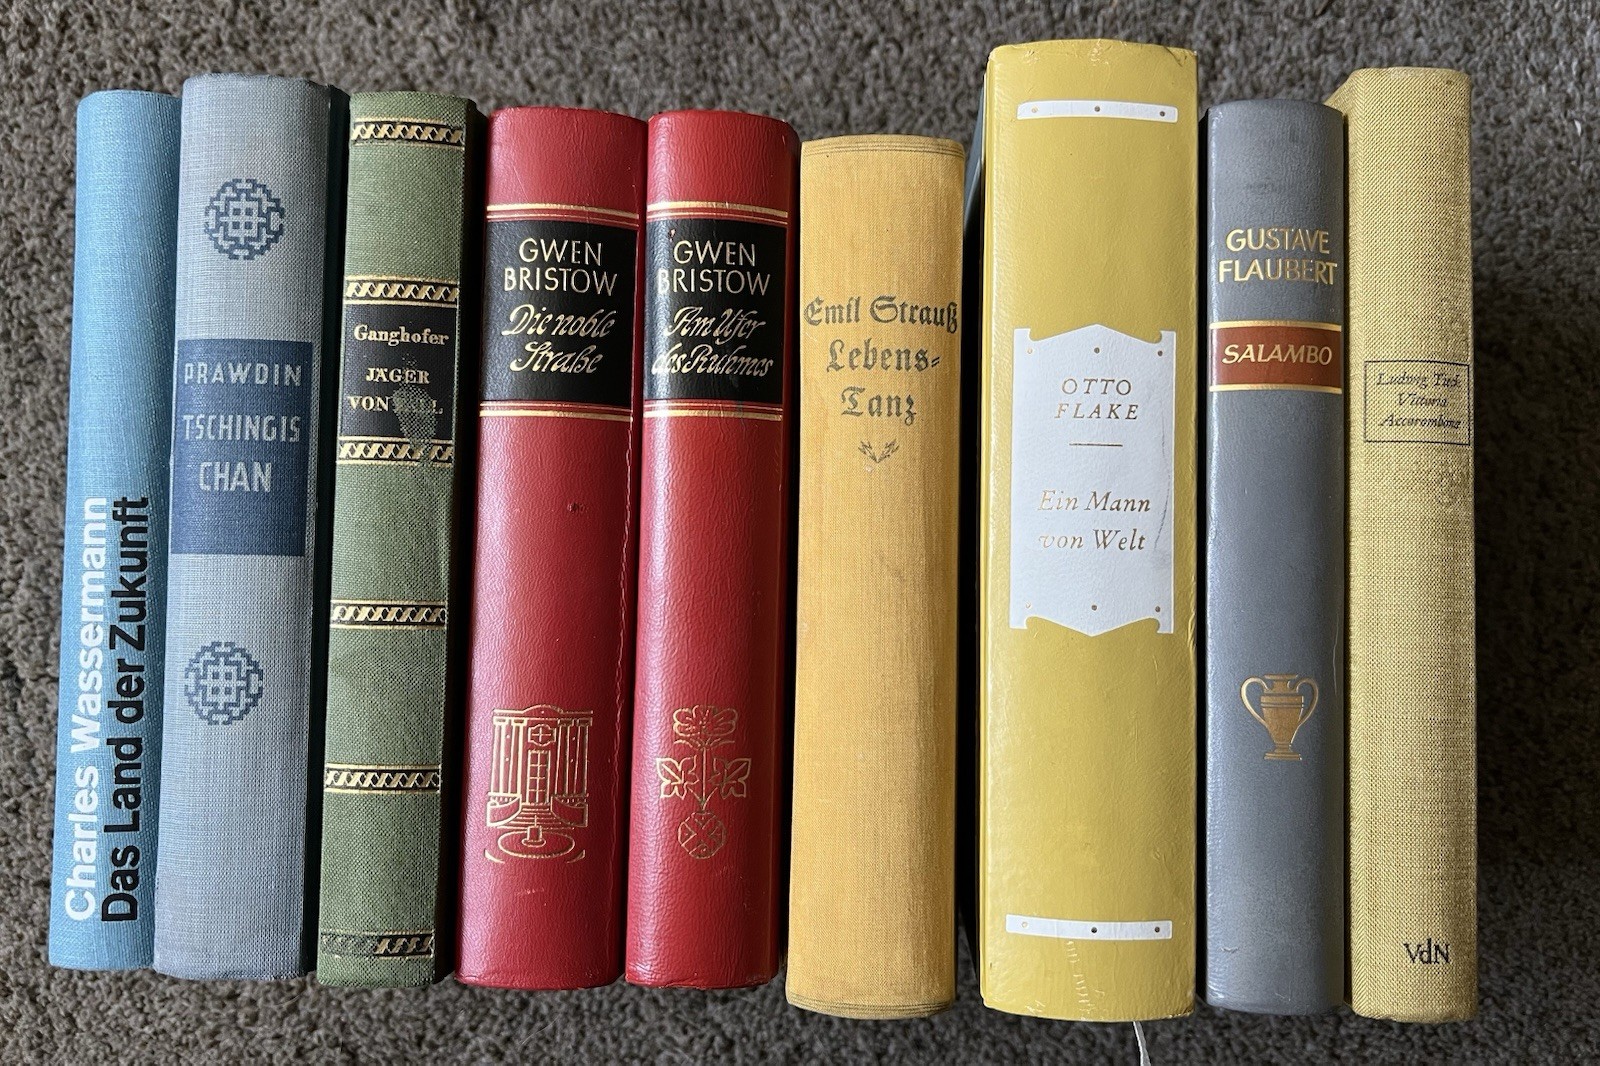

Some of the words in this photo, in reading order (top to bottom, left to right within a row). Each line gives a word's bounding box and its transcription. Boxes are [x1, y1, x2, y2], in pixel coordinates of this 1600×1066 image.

[518, 237, 602, 266] GWEN
[673, 240, 755, 267] GWEN
[1226, 227, 1330, 254] GUSTAVE
[503, 267, 618, 296] BRISTOW
[657, 268, 771, 296] BRISTOW
[1218, 259, 1338, 285] FLAUBERT
[501, 303, 550, 337] Die
[551, 308, 617, 338] noble
[663, 306, 716, 337] Am
[713, 308, 767, 345] Ufer
[803, 296, 861, 326] Emil
[869, 295, 958, 334] Strauß
[354, 324, 449, 346] Ganghofer
[510, 341, 603, 374] Straße
[651, 342, 687, 375] des
[681, 343, 774, 377] Ruhmes
[1221, 343, 1333, 366] SALAMBO
[184, 362, 302, 387] PRAWDIN
[366, 366, 430, 384] JÄGER
[1062, 378, 1132, 396] OTTO
[1376, 371, 1428, 389] Ludwig
[347, 395, 390, 412] VON
[841, 386, 917, 426] Tanz
[1054, 403, 1139, 420] FLAKE
[183, 413, 301, 443] TSCHINGIS
[200, 461, 272, 493] CHAN
[1038, 490, 1078, 511] Ein
[1084, 491, 1151, 512] Mann
[1038, 535, 1084, 549] von
[1093, 528, 1146, 550] Welt
[109, 496, 150, 650] Zukunft
[70, 497, 108, 753] Wassermann
[108, 657, 145, 723] der
[104, 737, 143, 832] Land
[65, 764, 99, 921] Charles
[100, 845, 140, 923] Das
[1403, 937, 1451, 965] VdN
